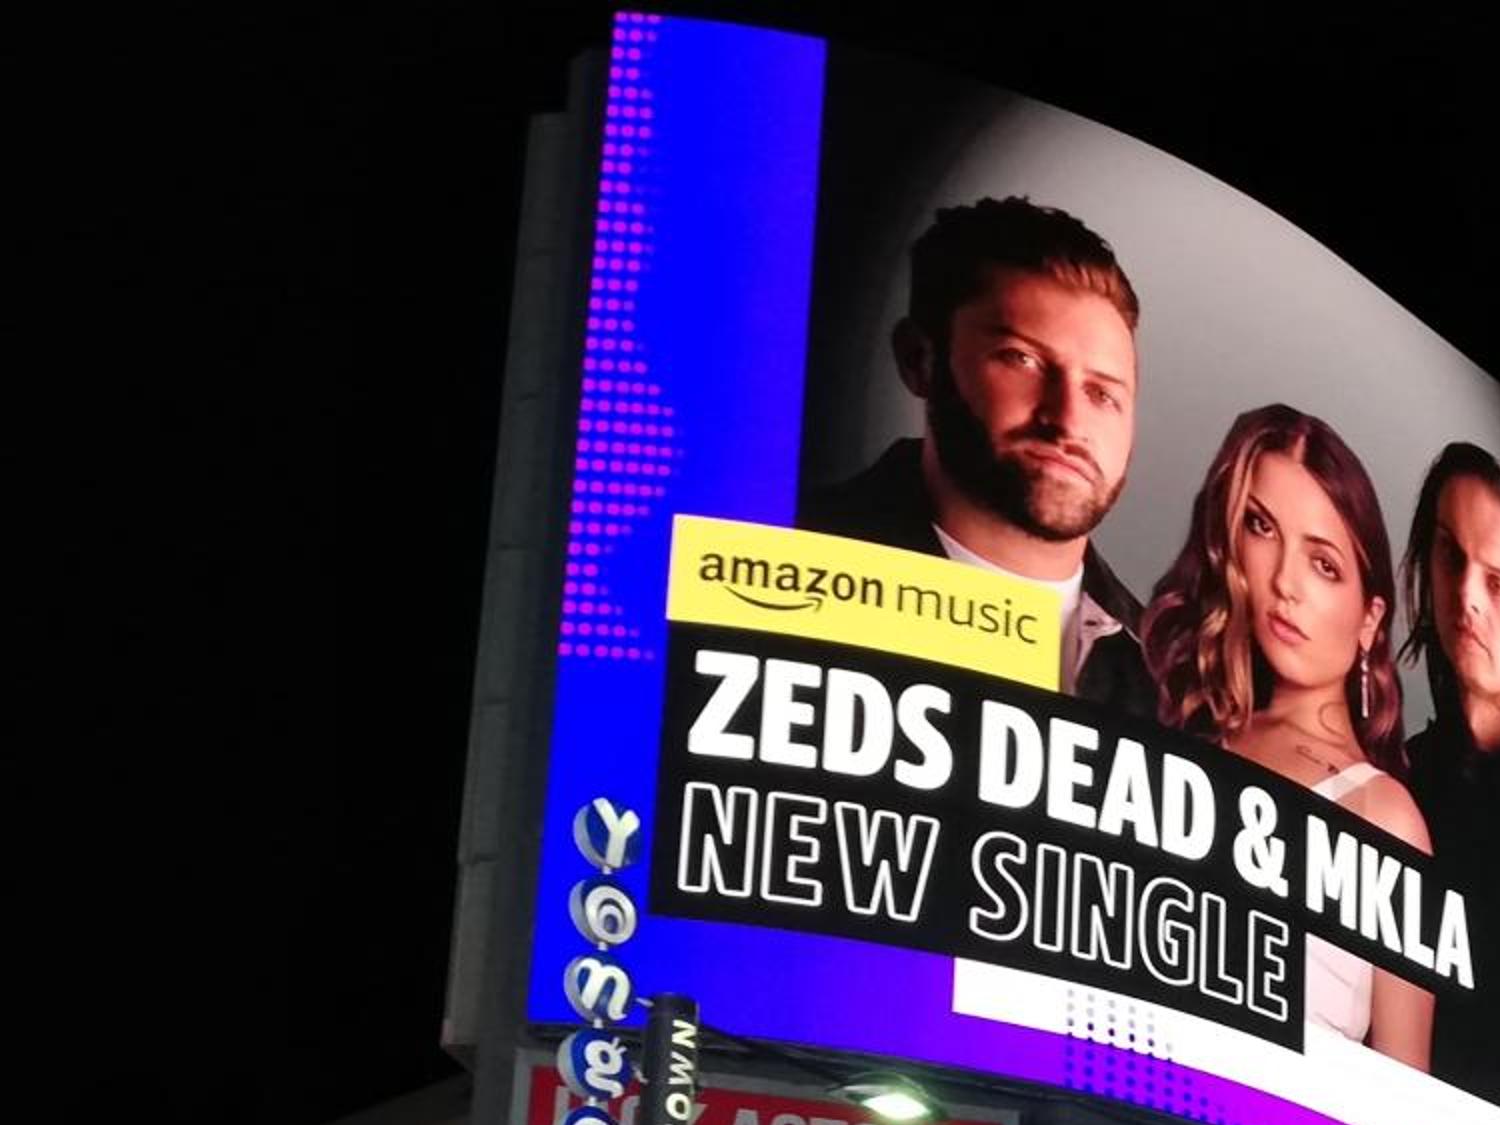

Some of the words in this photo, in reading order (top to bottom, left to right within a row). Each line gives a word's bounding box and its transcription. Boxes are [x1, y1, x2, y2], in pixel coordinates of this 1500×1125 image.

[699, 552, 883, 608] amazon
[896, 583, 1038, 645] music
[677, 780, 941, 923] NEW
[969, 830, 1290, 1023] SINGLE
[687, 649, 954, 791] ZEDS
[978, 699, 1216, 861] DEAD
[1232, 786, 1289, 898] &
[1305, 813, 1475, 990] MKLA
